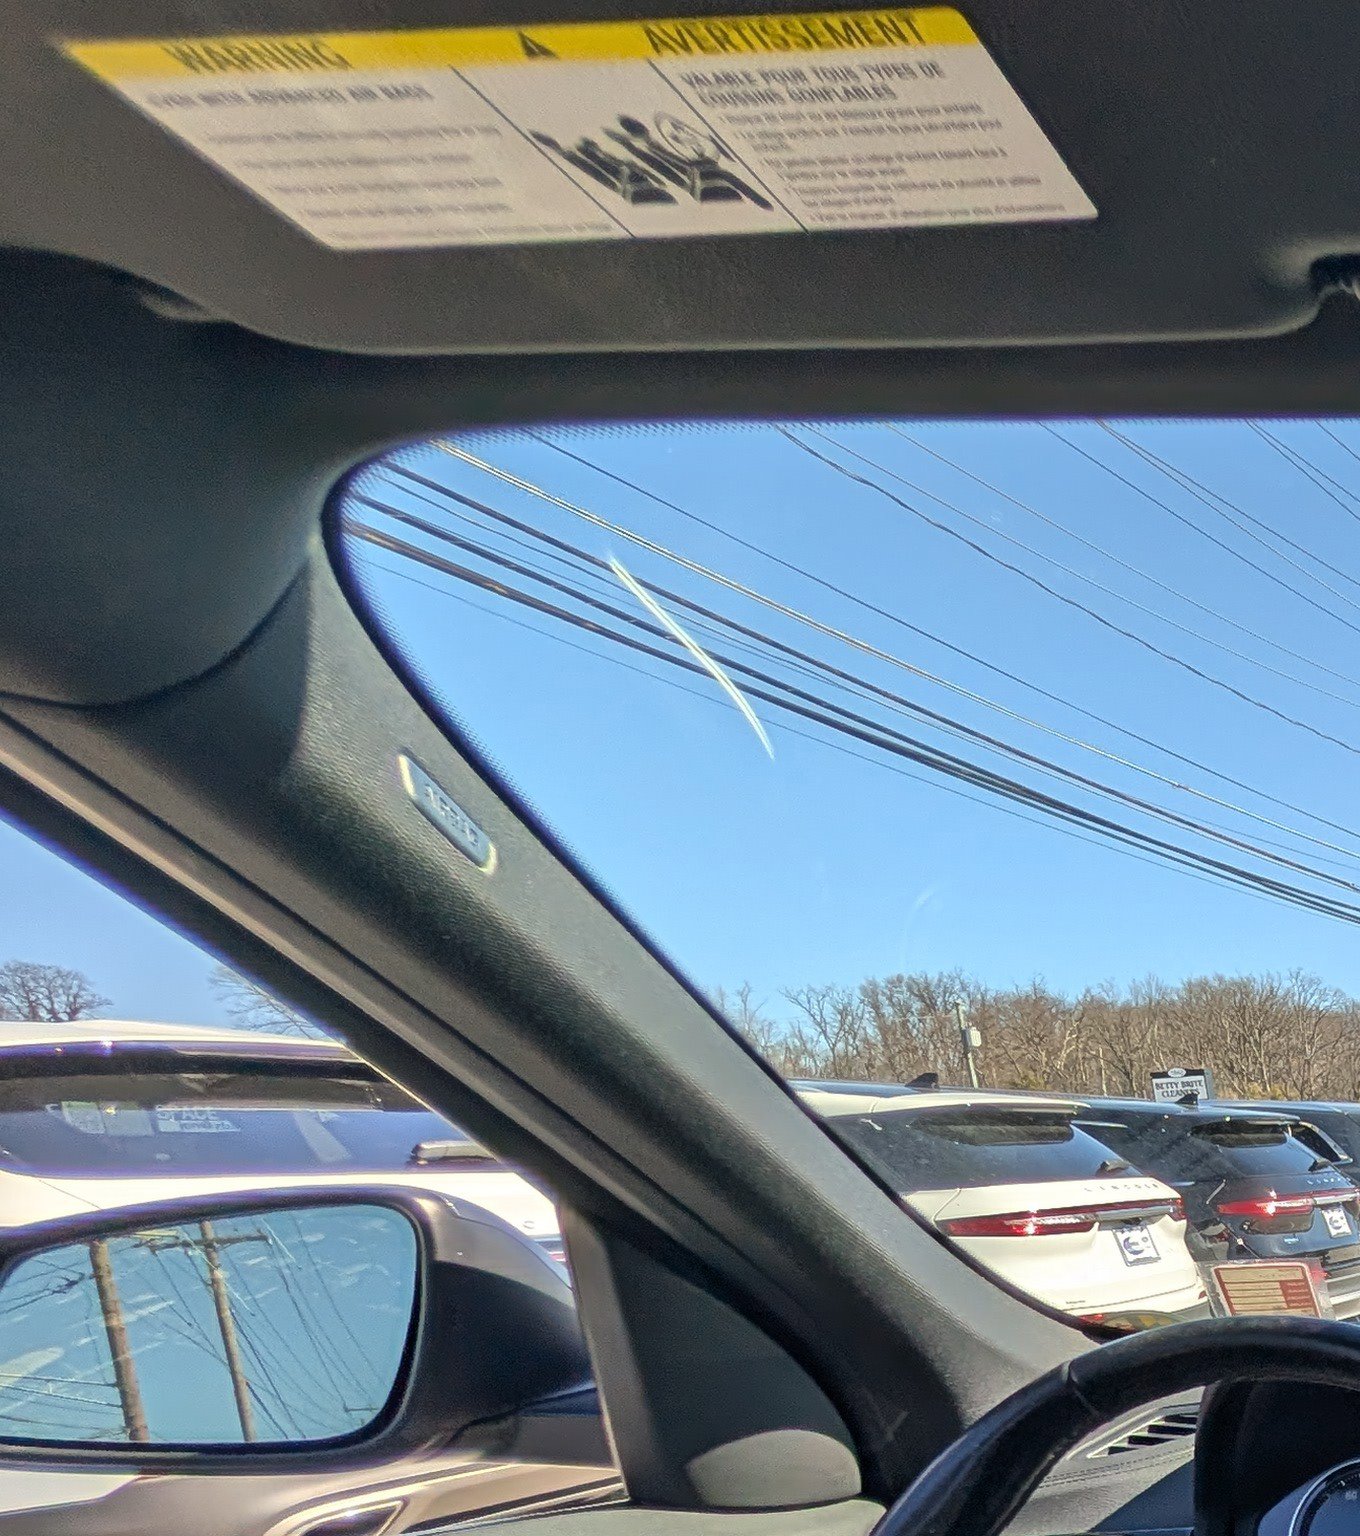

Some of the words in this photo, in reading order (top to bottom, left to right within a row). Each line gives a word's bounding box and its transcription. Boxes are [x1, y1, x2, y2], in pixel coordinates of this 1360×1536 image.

[644, 14, 927, 56] AVERTISSEMENT
[163, 39, 352, 73] WARNING
[860, 62, 918, 81] TYPES
